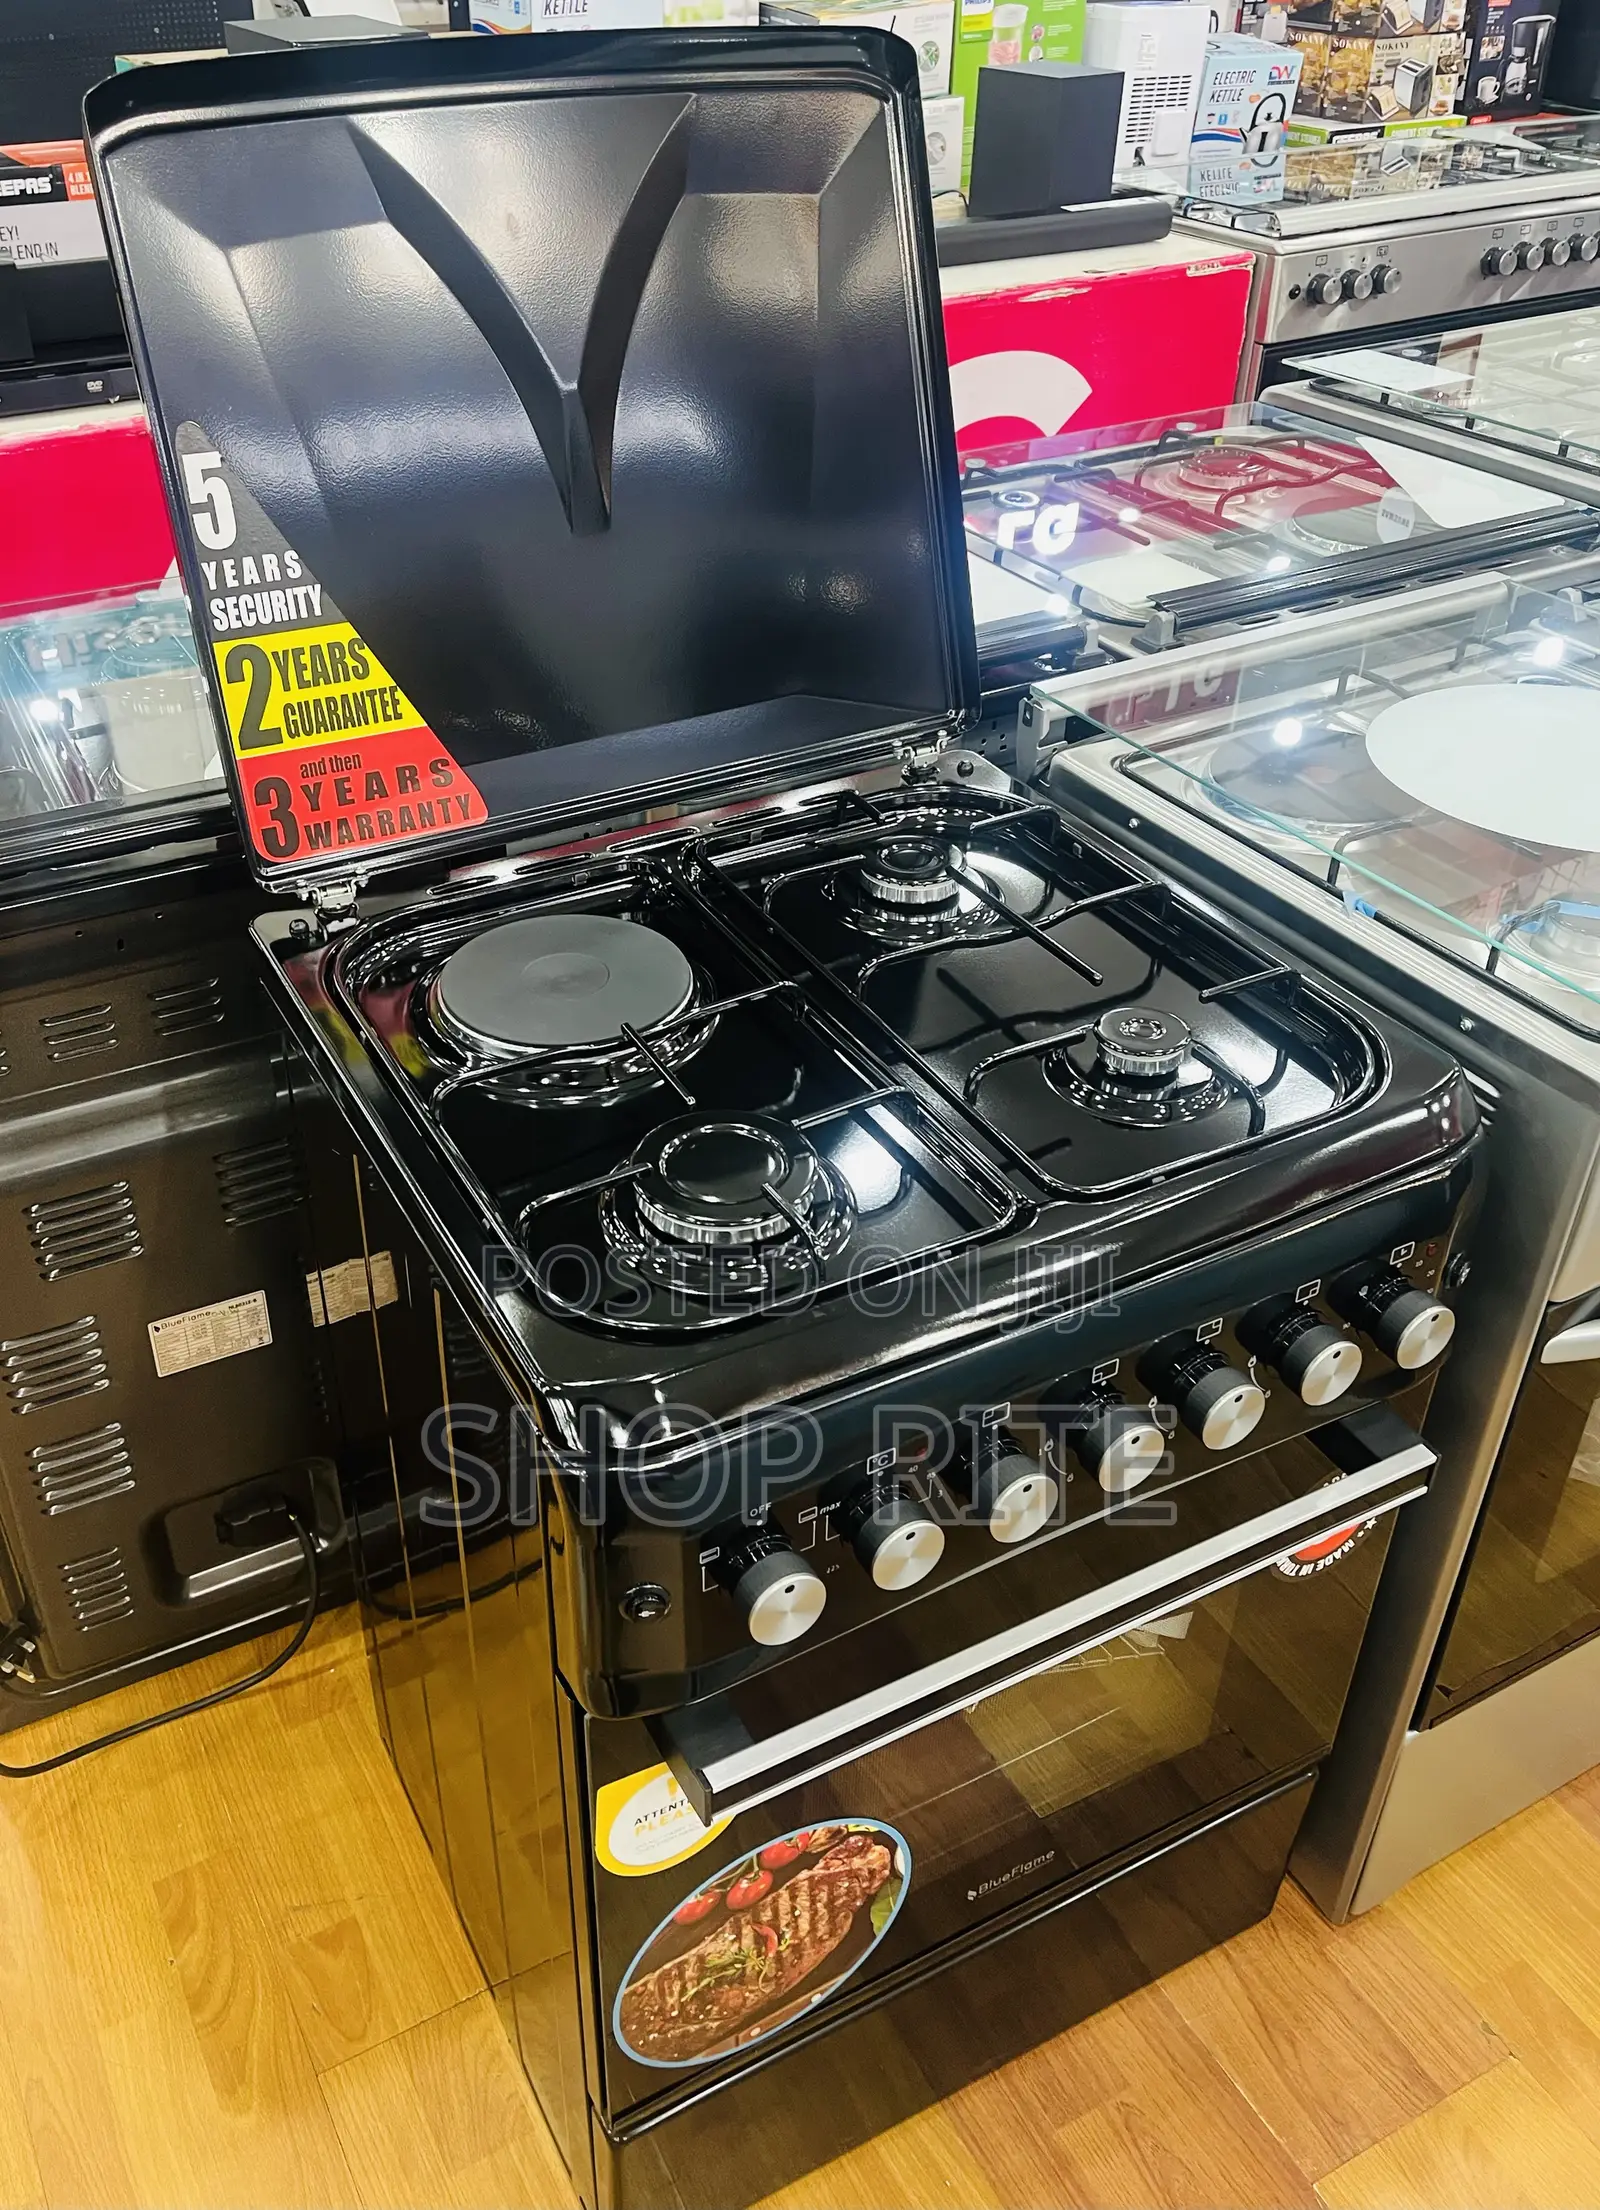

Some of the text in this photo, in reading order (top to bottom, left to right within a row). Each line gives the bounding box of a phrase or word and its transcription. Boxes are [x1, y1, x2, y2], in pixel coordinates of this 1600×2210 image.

[544, 0, 588, 16] KETTLE
[1213, 70, 1257, 86] ELECTRIC
[1209, 88, 1244, 104] KETTLE
[0, 176, 52, 196] EPAS
[45, 241, 59, 256] IN
[181, 450, 237, 551] 5
[201, 550, 303, 592] YEARS
[210, 583, 322, 632] SECURITY
[225, 637, 370, 751] 2 YEARS
[282, 685, 403, 740] GUARANTEE
[299, 752, 362, 779] and then
[254, 757, 455, 858] 3 YEARS
[304, 793, 472, 852] WARRANTY
[161, 1311, 212, 1331] BlueFlame
[750, 1502, 772, 1517] OFF
[819, 1501, 841, 1515] max
[1315, 1538, 1356, 1572] MADE
[1298, 1563, 1315, 1577] IN
[633, 1798, 689, 1827] ATTENT
[978, 1850, 1055, 1895] BlueFlame
